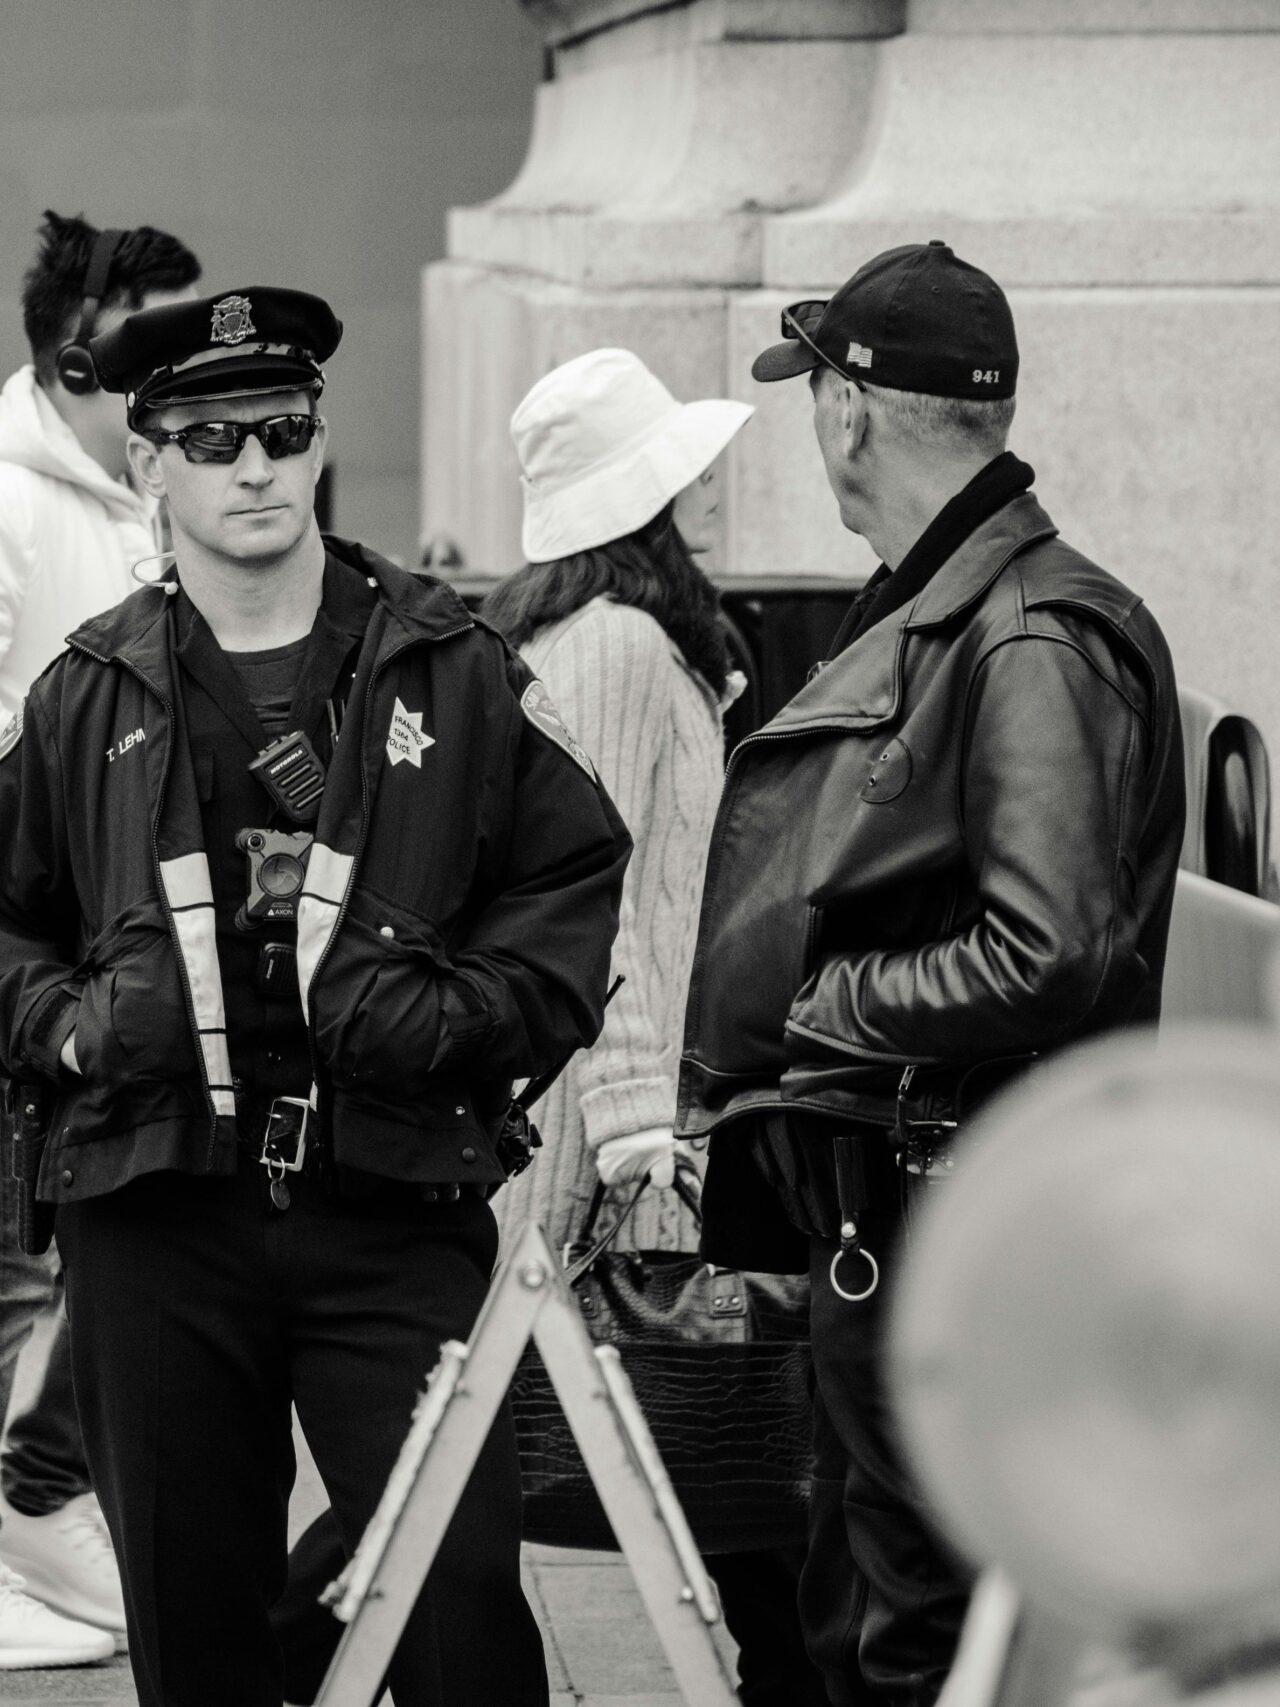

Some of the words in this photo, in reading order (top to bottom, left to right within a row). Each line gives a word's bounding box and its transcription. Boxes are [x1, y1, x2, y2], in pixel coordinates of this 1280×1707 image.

[972, 369, 1000, 383] 941
[394, 715, 424, 746] FRANCISCO
[106, 748, 115, 762] T.
[270, 749, 303, 775] MOTOROLA
